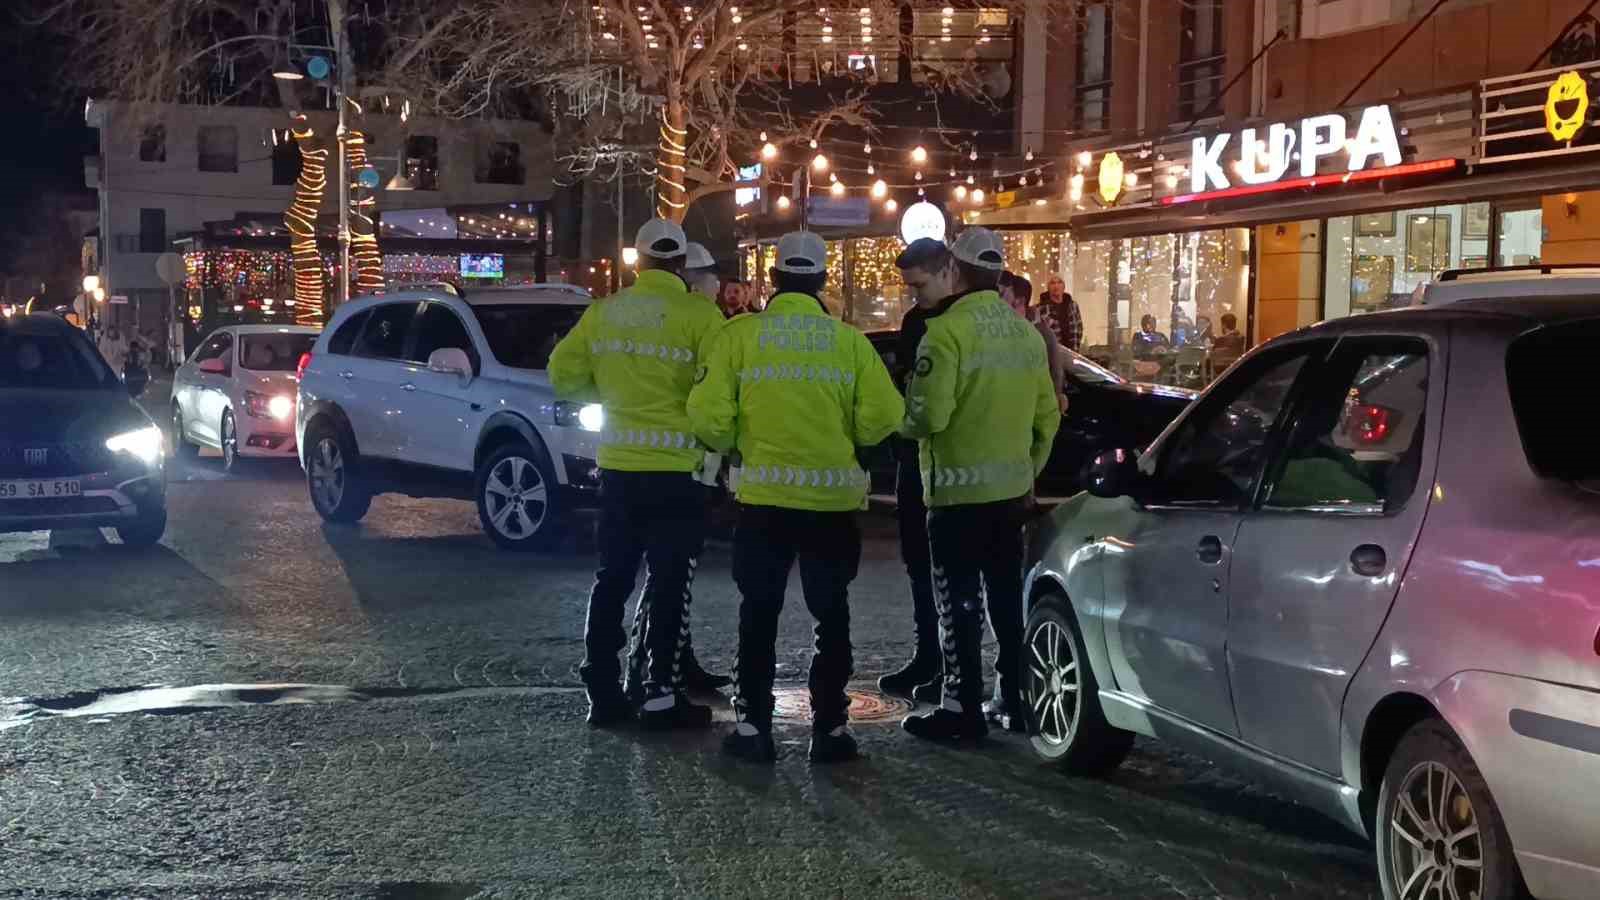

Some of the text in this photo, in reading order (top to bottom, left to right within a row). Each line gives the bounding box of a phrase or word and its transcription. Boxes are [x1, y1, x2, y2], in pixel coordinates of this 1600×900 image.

[1191, 104, 1402, 193] KUPA
[24, 447, 48, 464] FIAT
[0, 481, 80, 497] 59 SA 510
